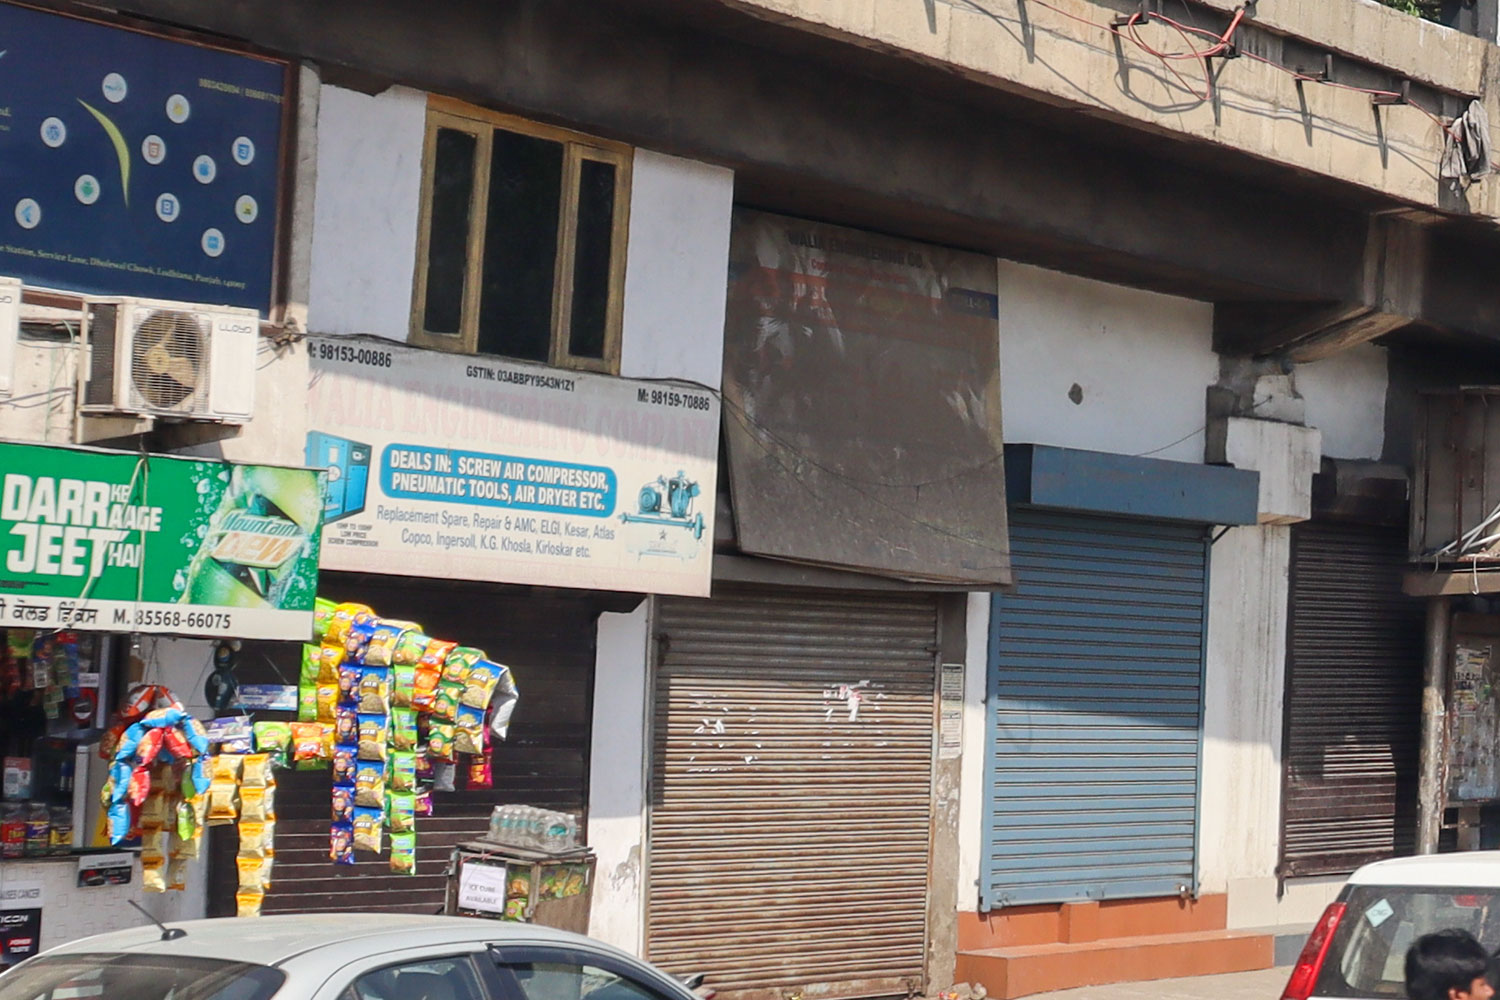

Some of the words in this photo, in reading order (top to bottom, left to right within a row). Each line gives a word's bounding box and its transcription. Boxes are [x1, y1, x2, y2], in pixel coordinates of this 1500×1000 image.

[218, 322, 253, 335] LLOYD
[319, 343, 392, 368] 98153-00886
[466, 365, 496, 381] GSTIN:
[637, 387, 649, 403] M:
[650, 390, 711, 412] 98159-70886
[390, 450, 432, 471] DEALS
[435, 454, 452, 473] IN:
[458, 456, 502, 478] SCREW
[503, 462, 525, 481] AIR
[527, 464, 609, 493] COMPRESSOR,
[1, 474, 111, 530] DARR
[111, 484, 131, 503] KE
[392, 472, 467, 497] PNEUMATIC
[468, 479, 513, 504] TOOLS,
[515, 484, 536, 504] AIR
[538, 487, 577, 508] DRYER
[579, 491, 605, 511] ETC.
[108, 504, 163, 532] AAGE
[222, 511, 302, 538] Mountain
[376, 504, 439, 524] Replacement
[441, 510, 471, 529] Spare,
[472, 513, 502, 532] Repair
[504, 515, 512, 531] &
[514, 517, 538, 535] AMC,
[564, 522, 591, 540] Kesar,
[593, 524, 616, 541] Atlas
[7, 522, 130, 577] JEET
[108, 543, 141, 568] HAI
[401, 527, 434, 548] Copco,
[436, 531, 478, 550] Ingersoll,
[480, 534, 499, 551] K.G.
[501, 536, 533, 555] Khosla,
[535, 539, 575, 558] Kirloskar
[575, 545, 592, 559] etc.
[113, 608, 131, 625] M.
[135, 609, 232, 630] 85568-66075
